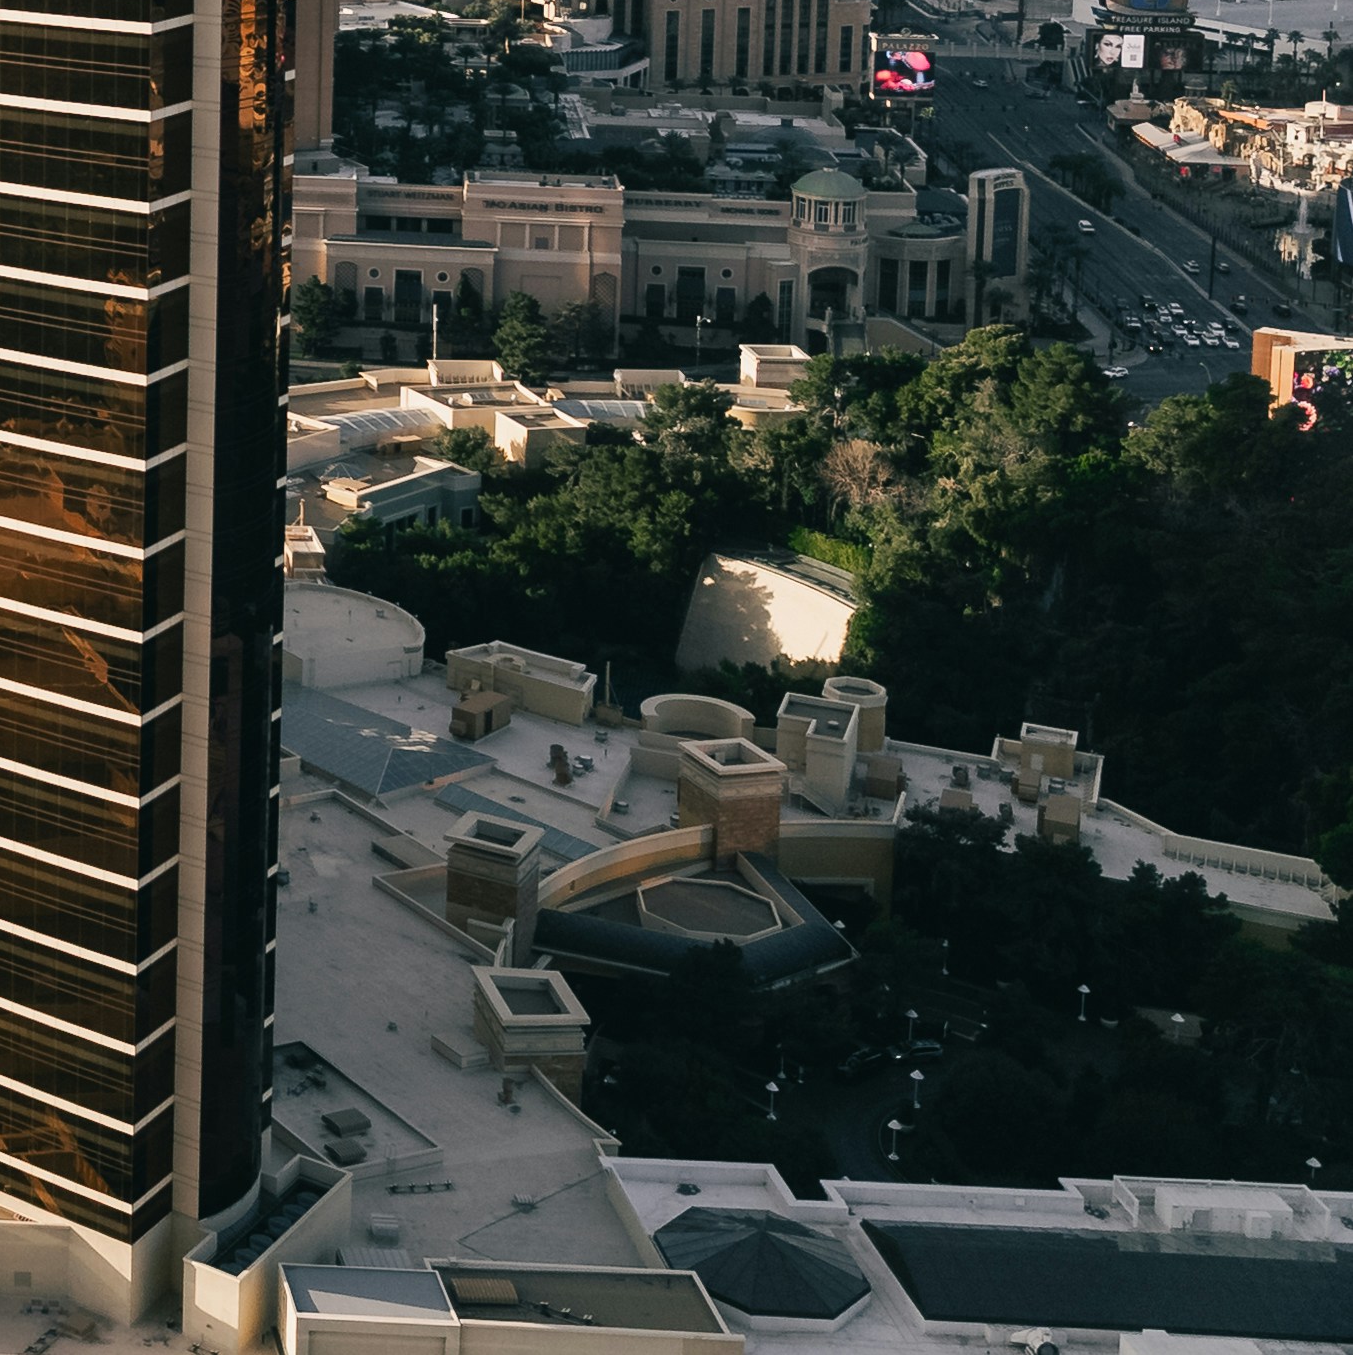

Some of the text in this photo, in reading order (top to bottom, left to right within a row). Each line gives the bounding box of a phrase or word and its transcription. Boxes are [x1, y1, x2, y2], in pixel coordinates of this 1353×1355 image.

[1112, 16, 1153, 24] TREASURE
[882, 42, 930, 51] PALAZZO
[508, 201, 548, 212] ASIAN
[554, 203, 603, 214] BISTRO
[625, 198, 703, 208] BURBERRY
